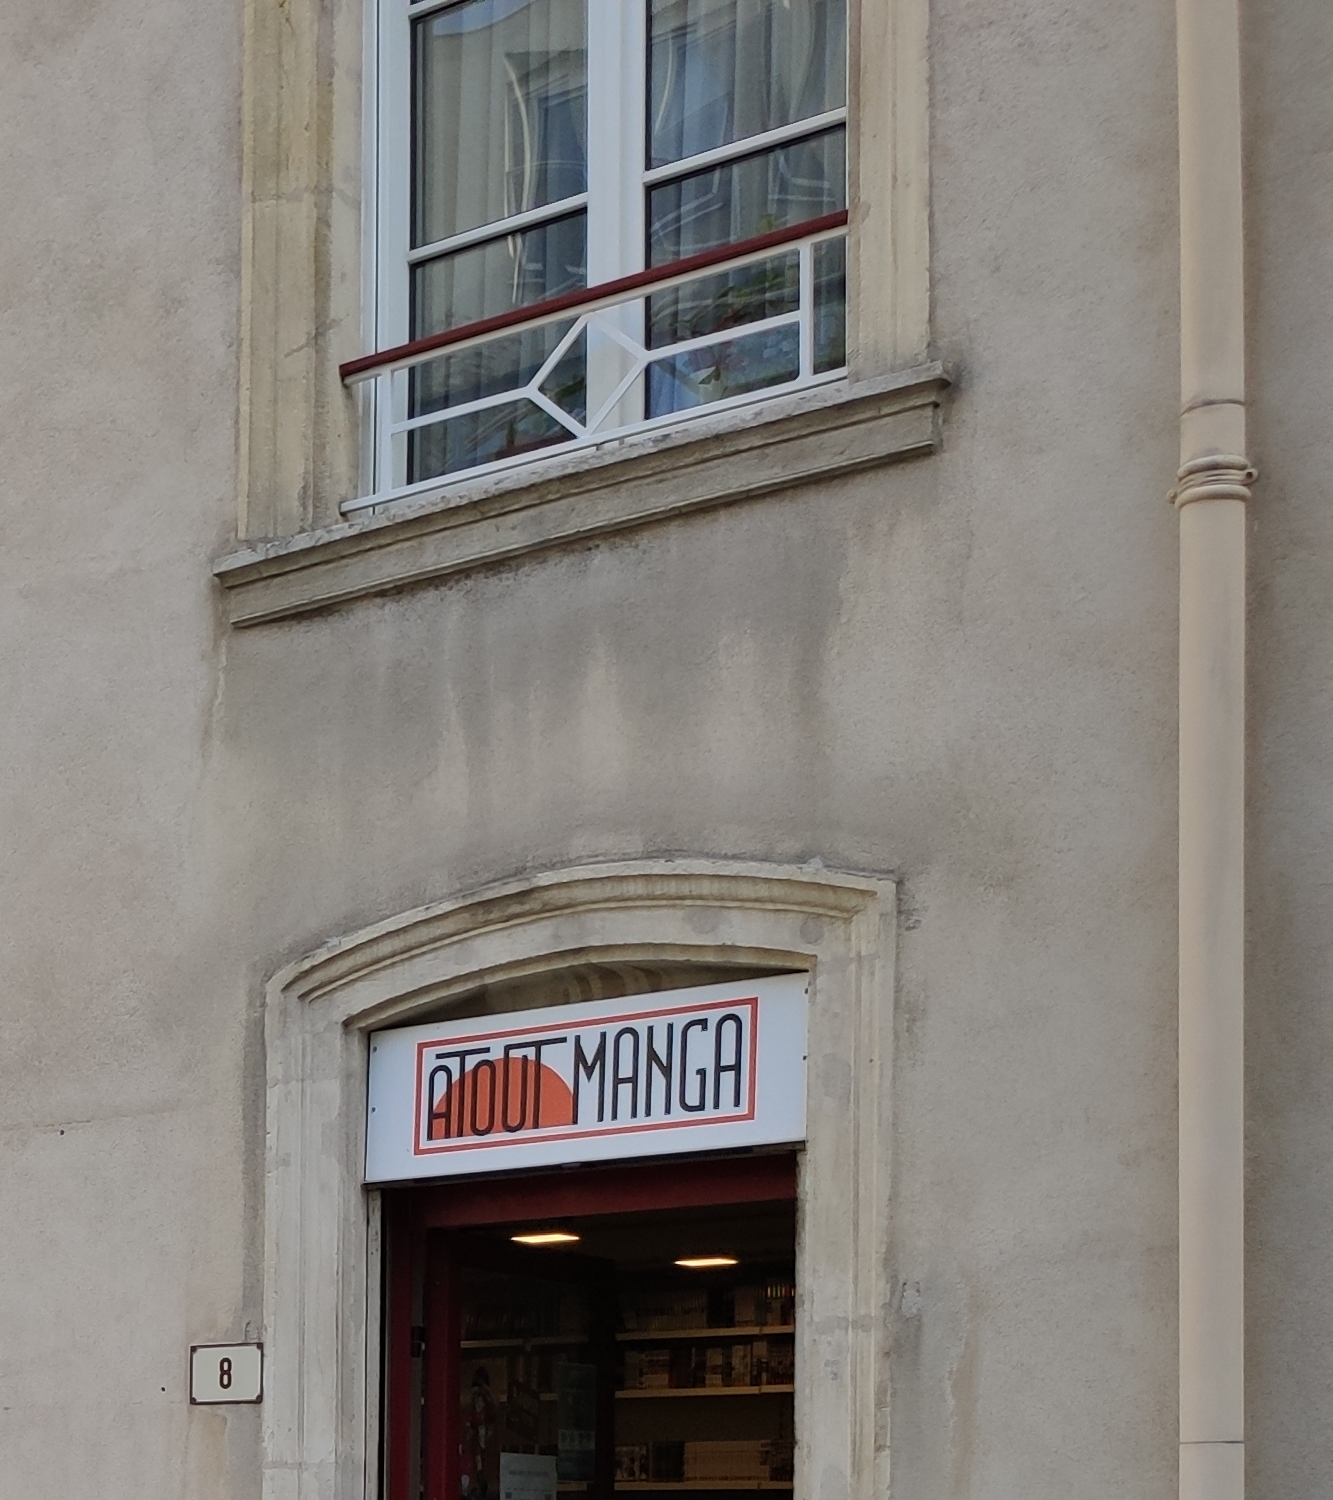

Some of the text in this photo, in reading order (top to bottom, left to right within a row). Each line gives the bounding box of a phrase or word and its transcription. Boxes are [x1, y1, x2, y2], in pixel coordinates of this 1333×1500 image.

[426, 1012, 744, 1141] ATOUT MANGA
[219, 1357, 233, 1390] 8
